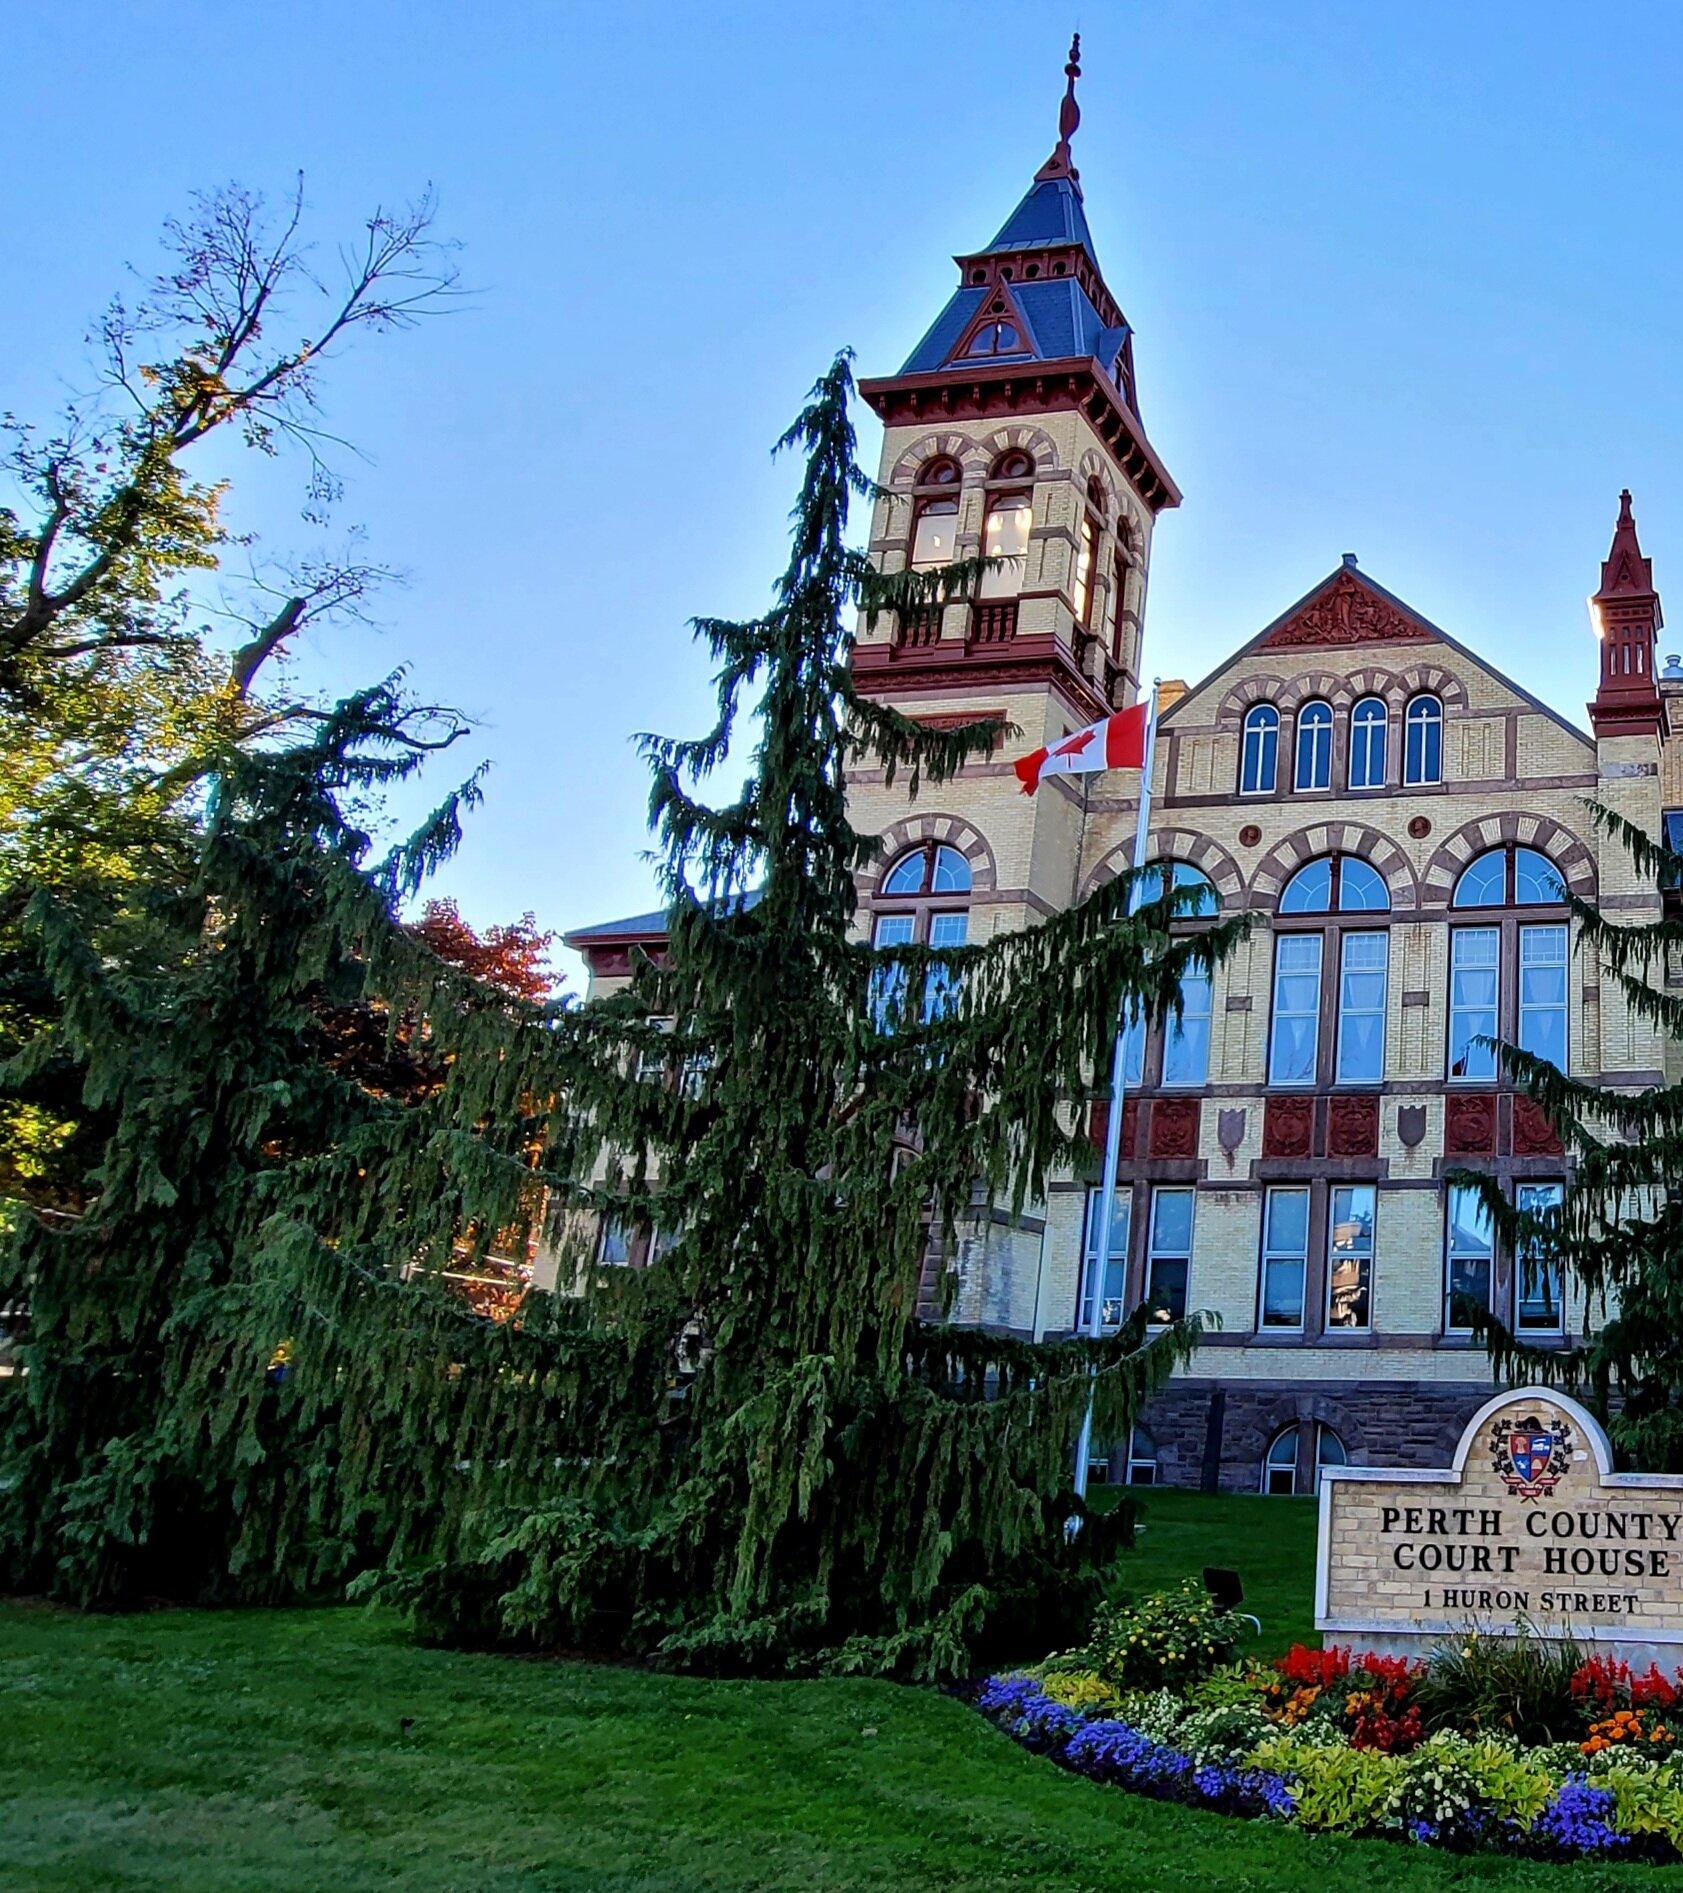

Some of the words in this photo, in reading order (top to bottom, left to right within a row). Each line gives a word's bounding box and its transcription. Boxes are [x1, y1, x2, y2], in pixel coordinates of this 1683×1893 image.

[1381, 1507, 1502, 1536] PERTH
[1526, 1511, 1682, 1540] COUNTY
[1394, 1543, 1520, 1572] COURT
[1543, 1547, 1670, 1577] HOUSE
[1423, 1588, 1431, 1608] 1
[1443, 1589, 1530, 1610] HURON
[1540, 1592, 1638, 1614] STREET
